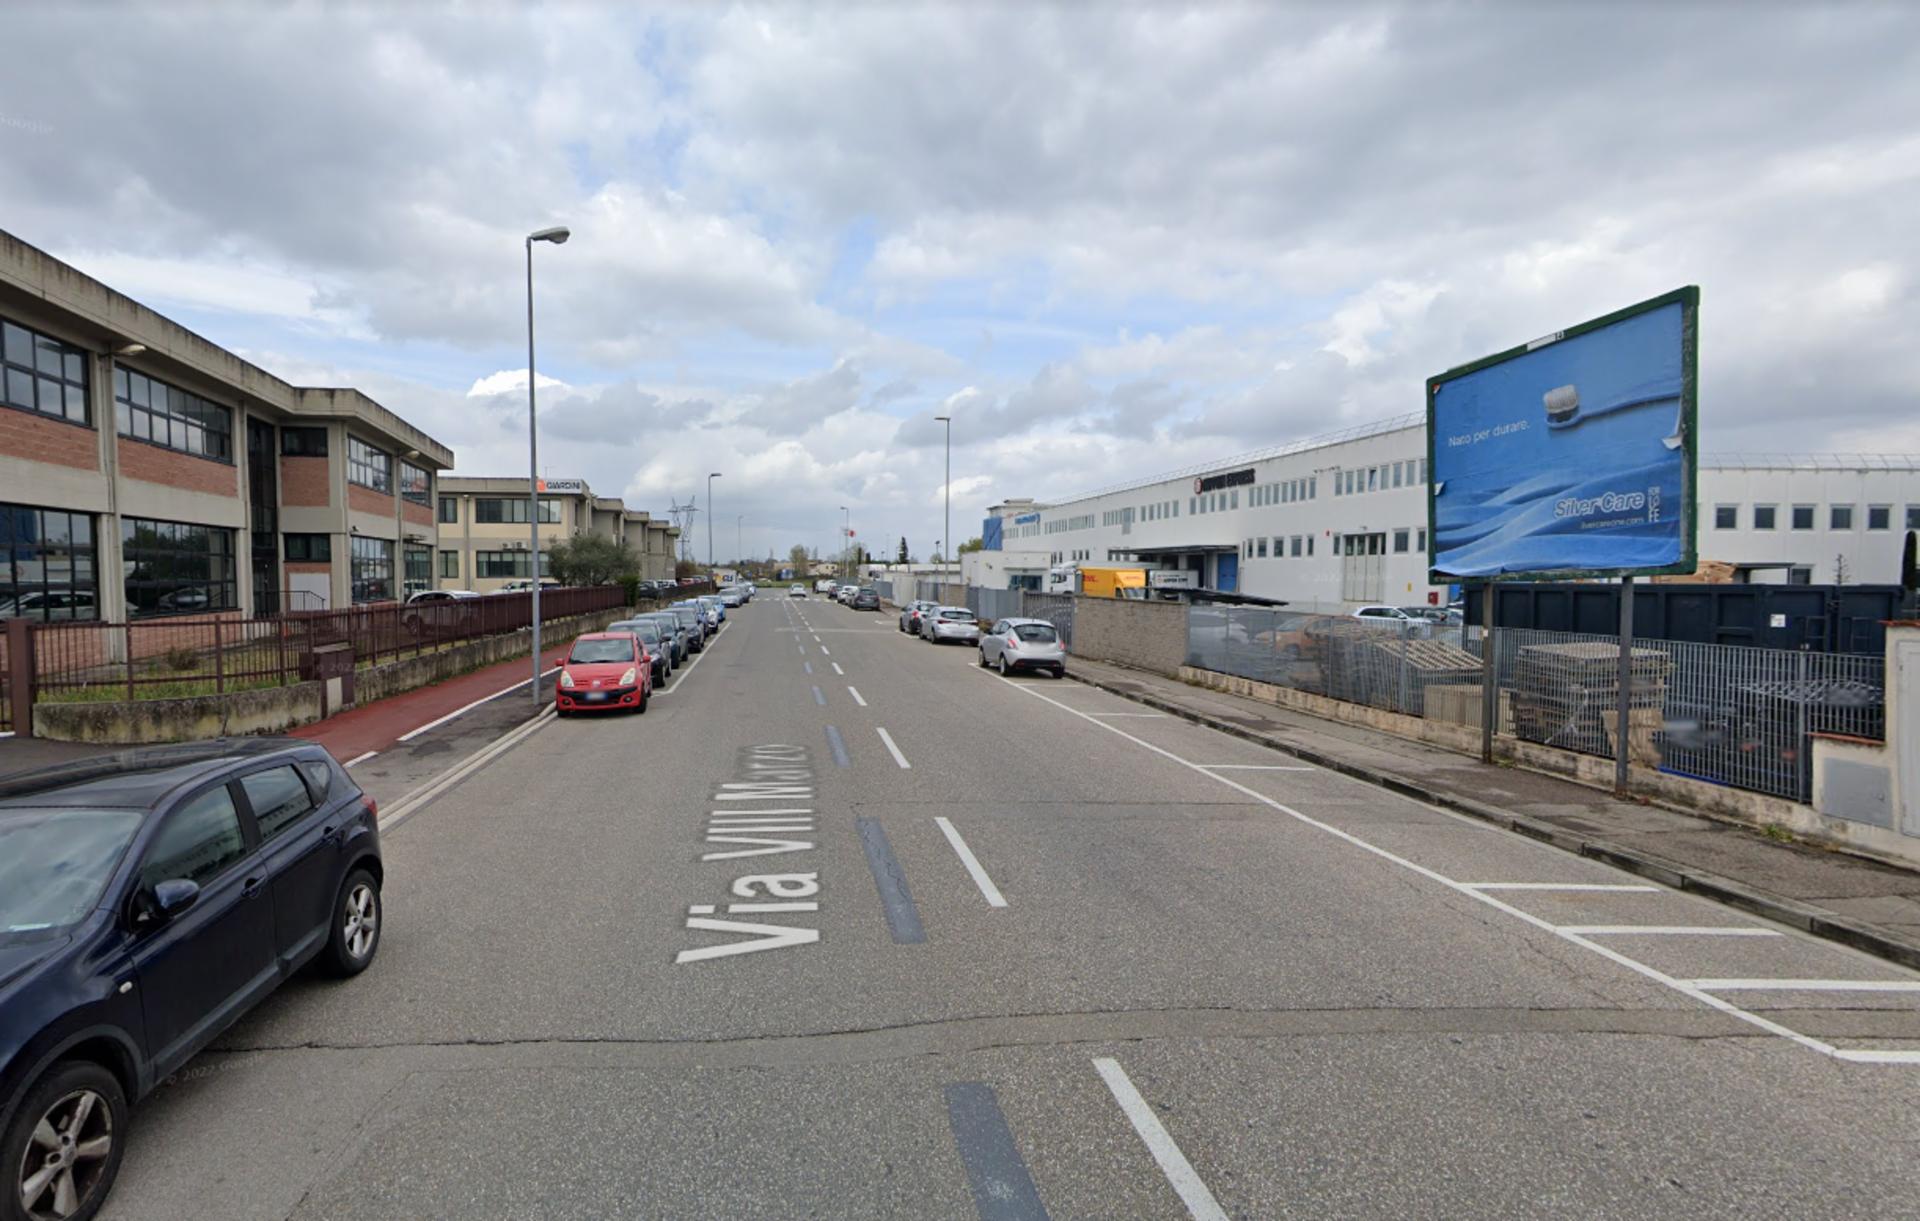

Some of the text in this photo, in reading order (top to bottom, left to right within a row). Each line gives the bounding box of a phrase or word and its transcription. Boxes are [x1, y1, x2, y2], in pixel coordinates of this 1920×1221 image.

[1448, 420, 1530, 447] Nato per durare.
